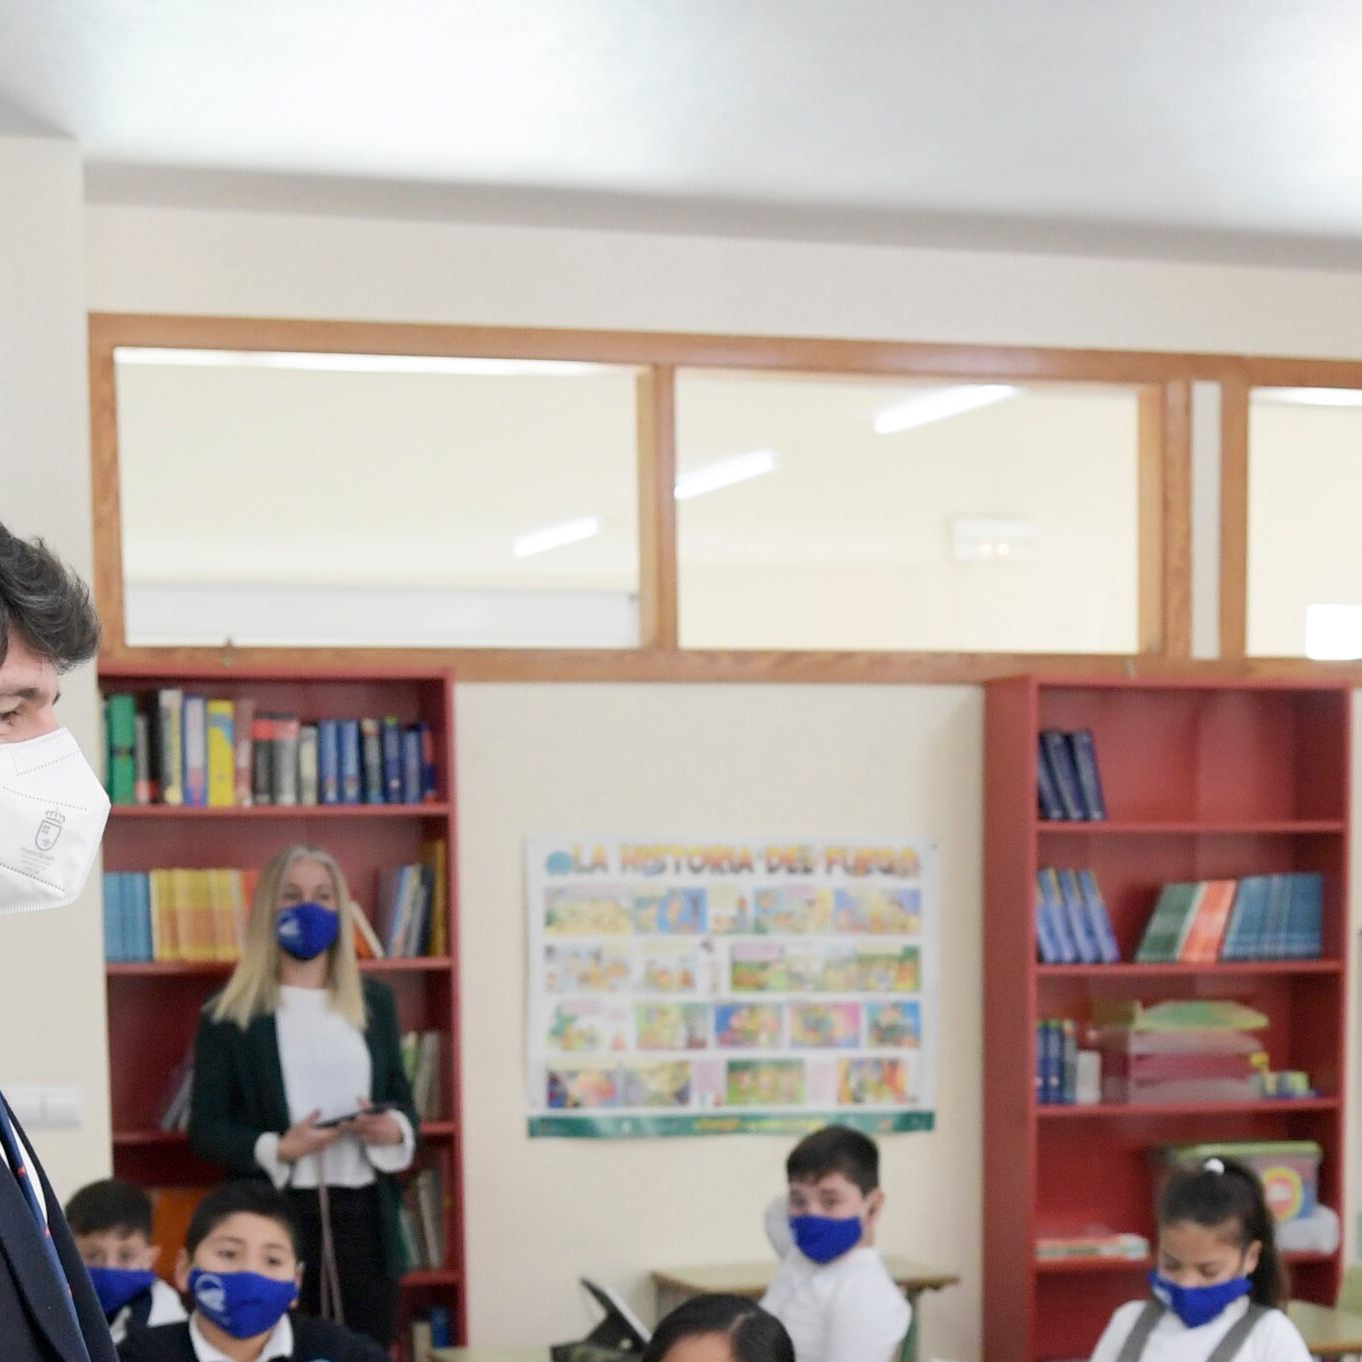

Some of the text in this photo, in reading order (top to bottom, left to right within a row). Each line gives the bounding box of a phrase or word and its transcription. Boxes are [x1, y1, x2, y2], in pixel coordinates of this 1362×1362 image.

[571, 843, 608, 874] LA
[620, 844, 755, 874] HISTORIA
[766, 844, 814, 874] DEL
